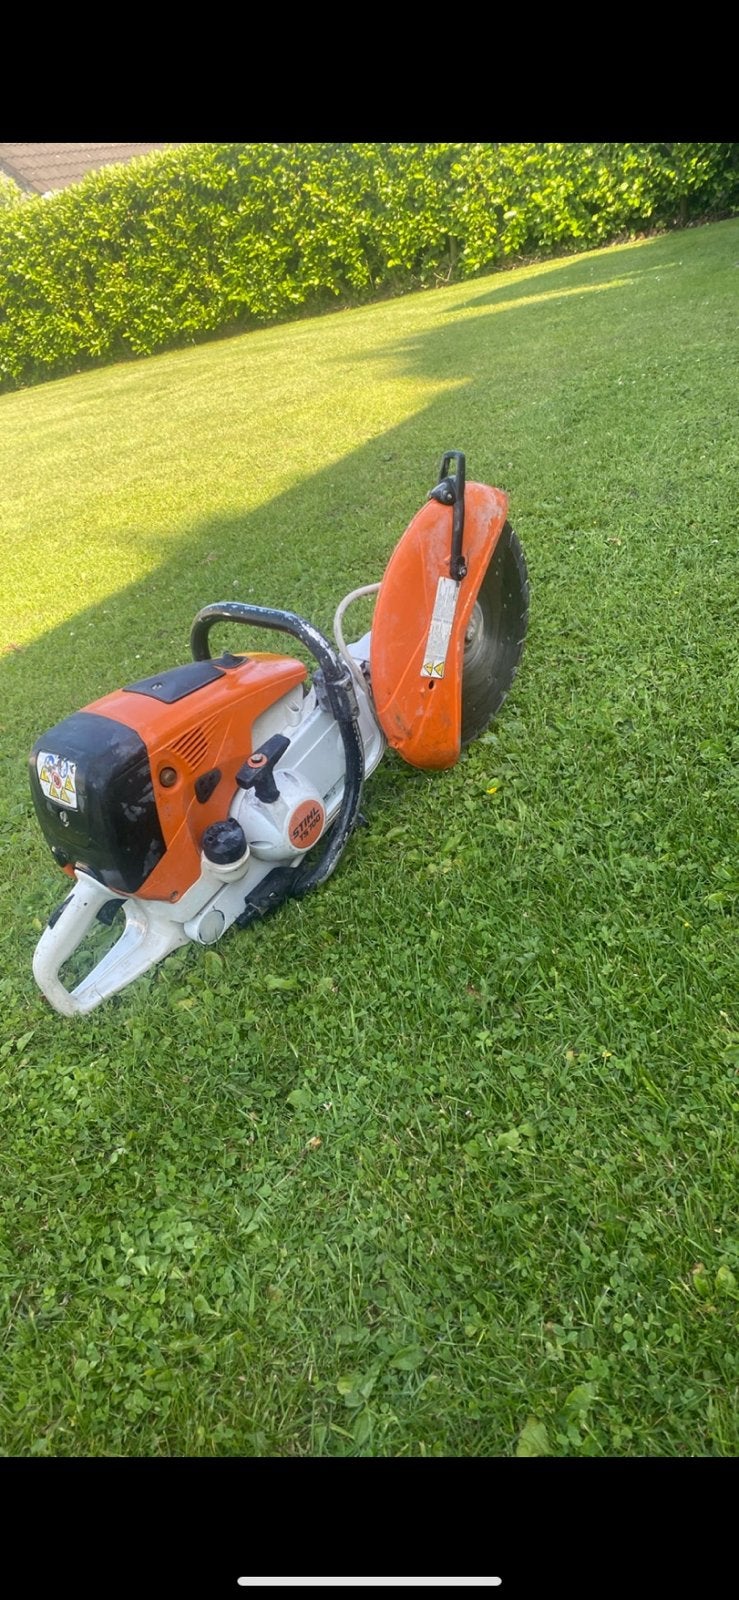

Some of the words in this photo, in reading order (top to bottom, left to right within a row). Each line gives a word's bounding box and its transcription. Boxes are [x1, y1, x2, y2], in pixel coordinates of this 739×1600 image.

[293, 808, 319, 839] STIHL
[299, 829, 309, 841] TS
[308, 814, 321, 831] 700
